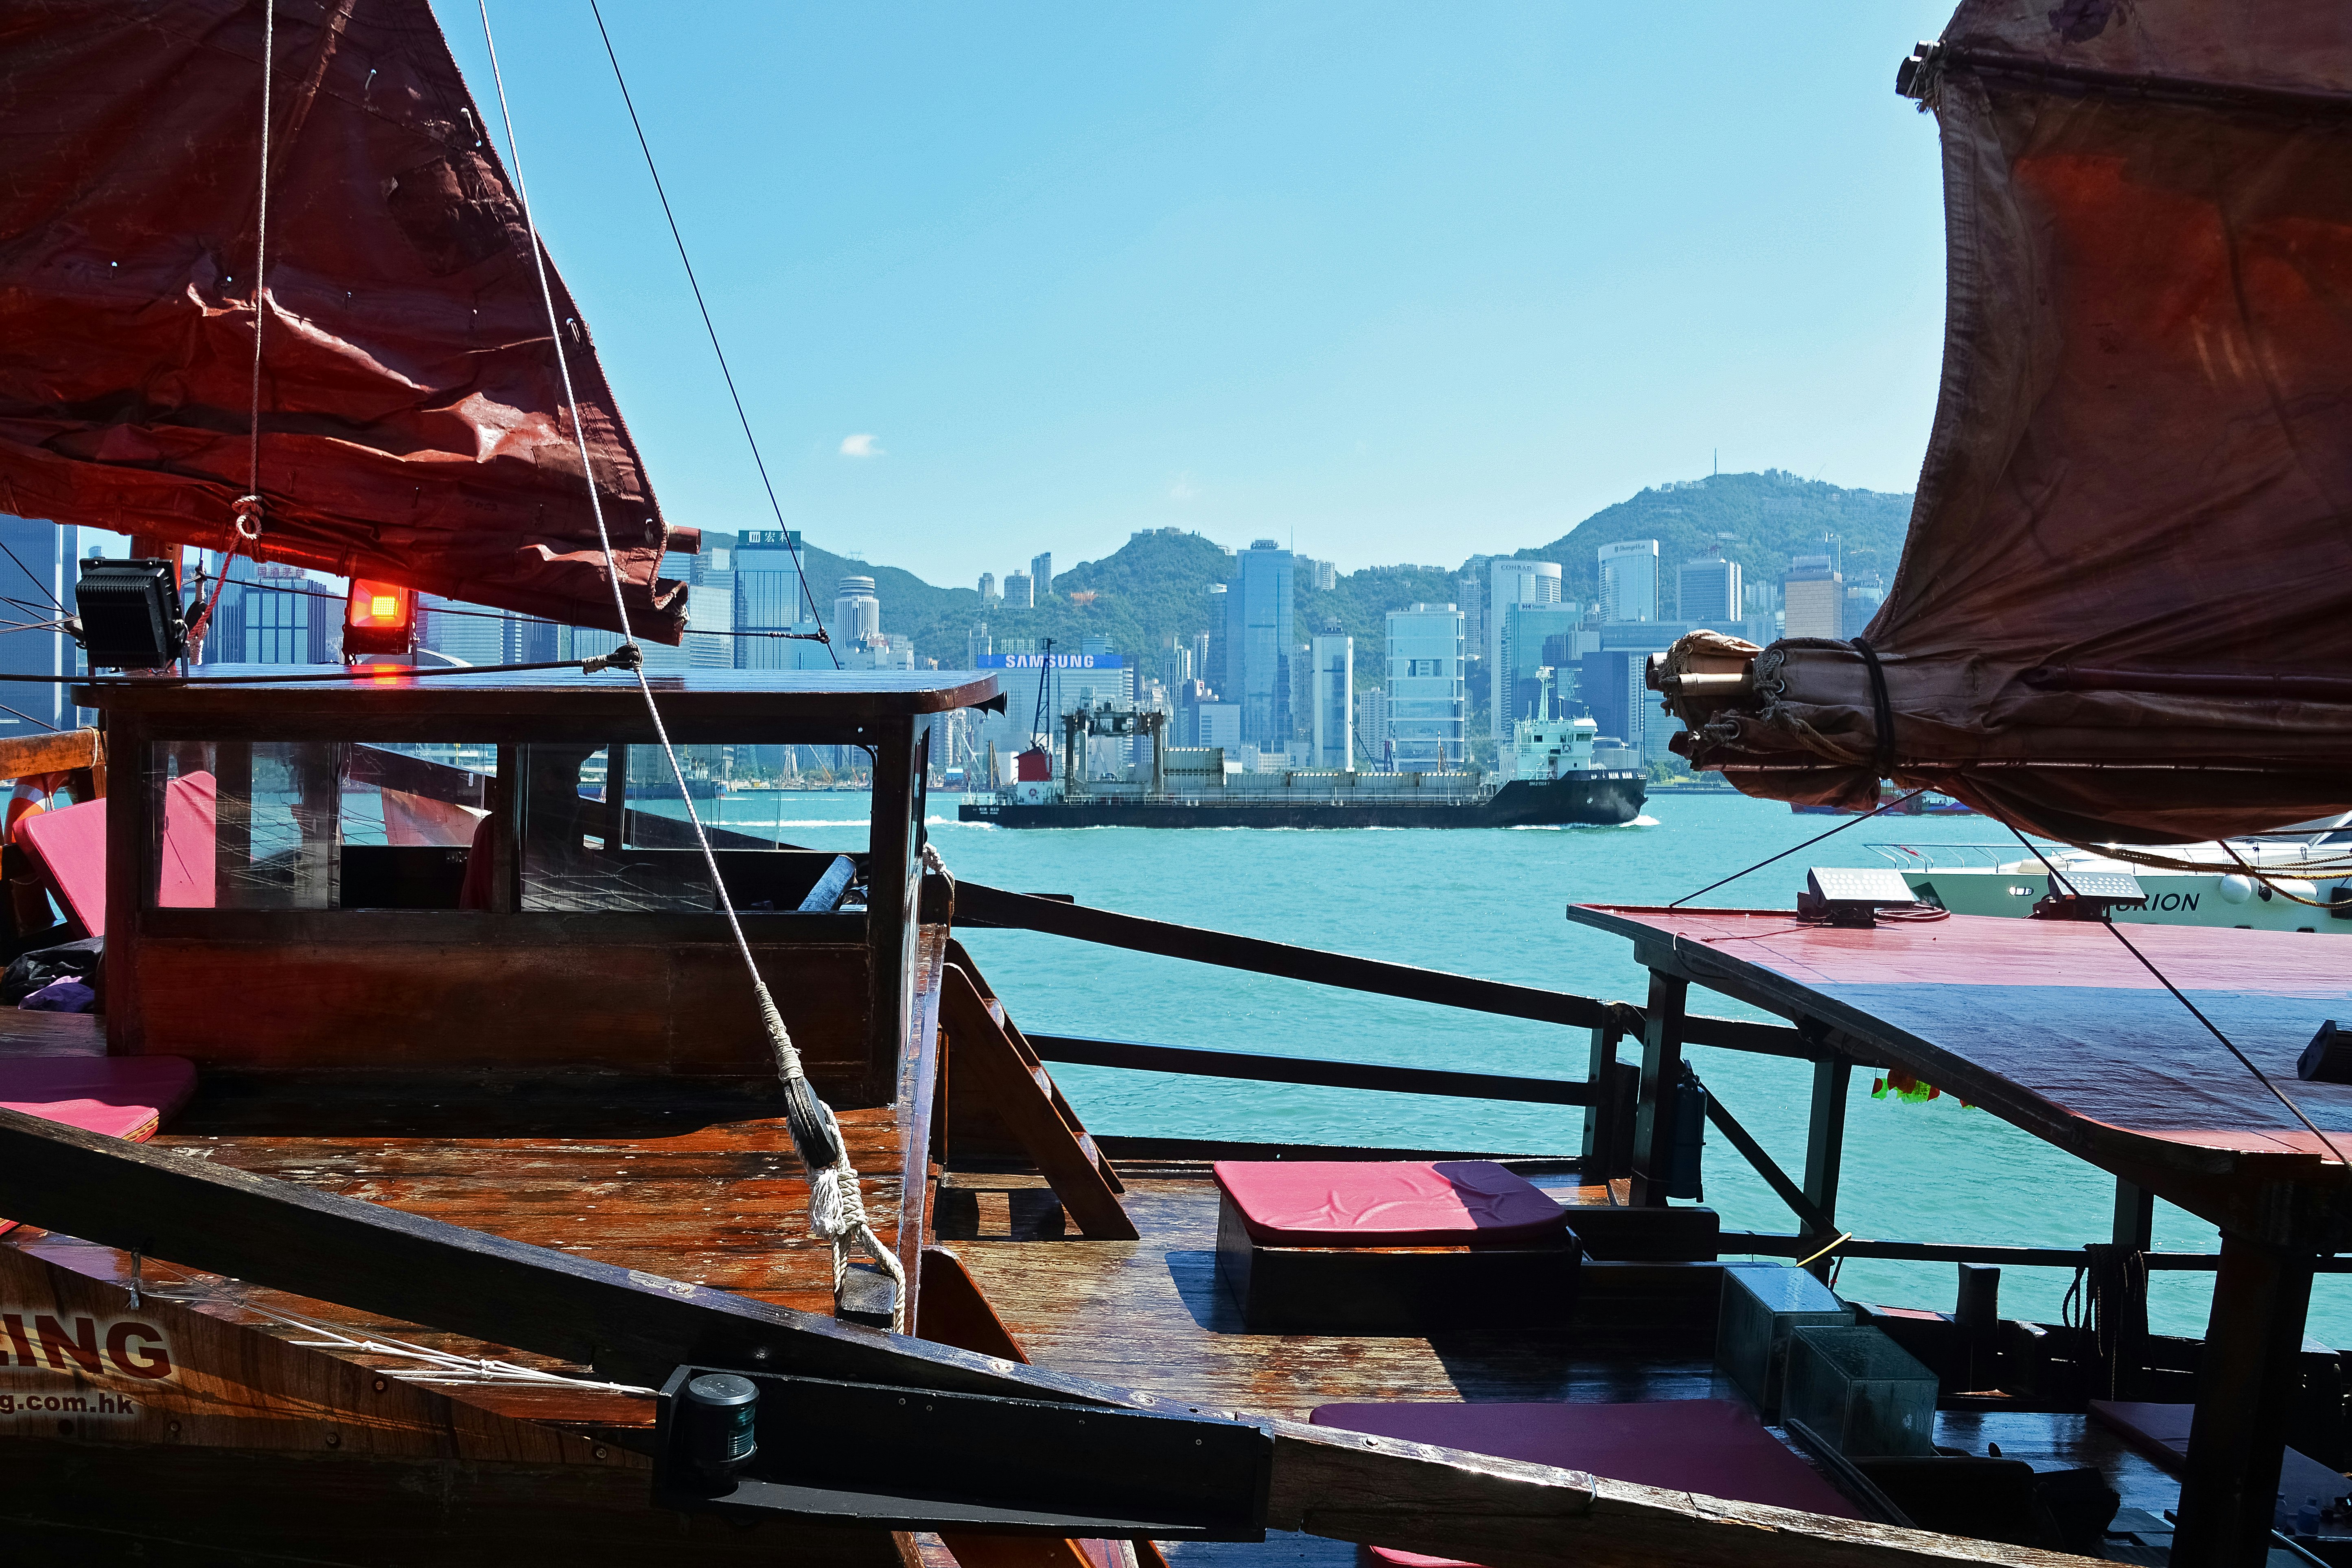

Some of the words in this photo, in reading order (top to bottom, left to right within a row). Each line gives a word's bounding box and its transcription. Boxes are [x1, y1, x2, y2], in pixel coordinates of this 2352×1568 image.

[765, 531, 790, 543] 宏利
[1005, 654, 1094, 668] SAMSUNG
[0, 1313, 172, 1379] ING
